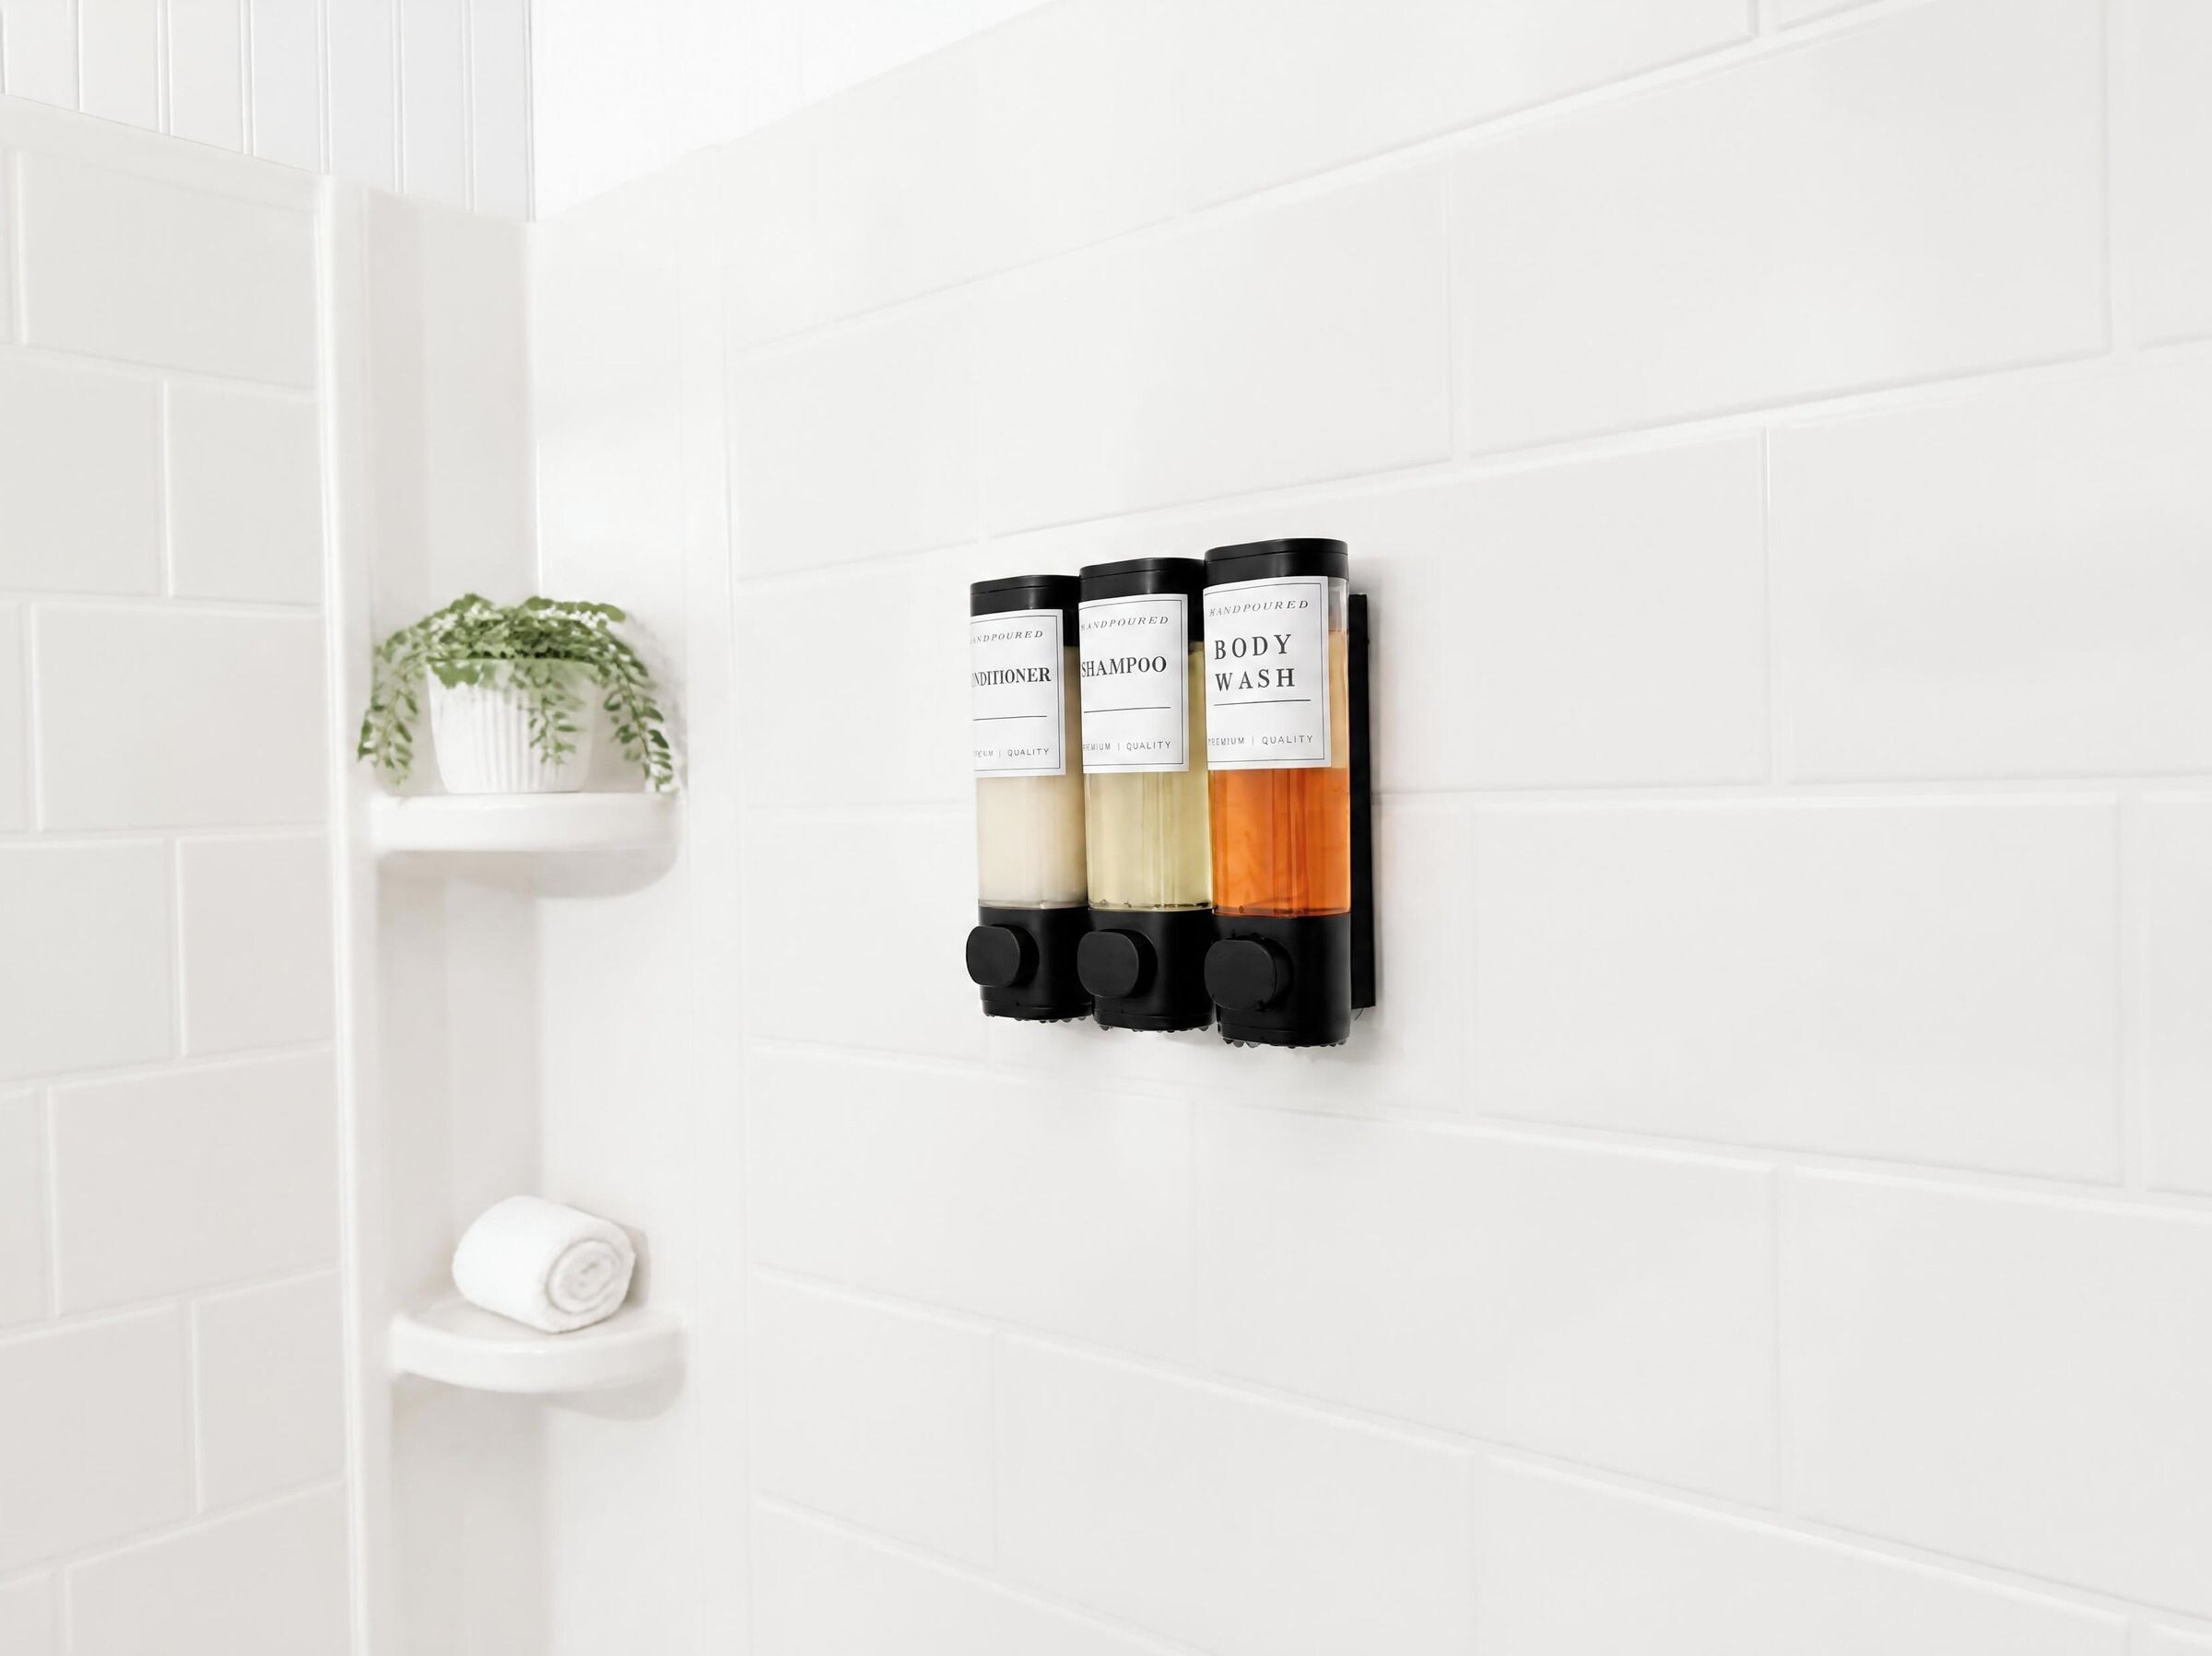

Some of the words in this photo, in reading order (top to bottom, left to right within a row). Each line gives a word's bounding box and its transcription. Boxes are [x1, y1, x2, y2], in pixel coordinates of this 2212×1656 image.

[1209, 600, 1309, 617] HANDPOURED
[972, 630, 1043, 643] ANDPOURED
[1214, 634, 1291, 660] BODY
[1081, 656, 1167, 677] SHAMPOO
[972, 667, 1052, 687] NDITIONER
[1215, 668, 1295, 692] WASH
[1126, 741, 1171, 751] QUALITY
[1262, 735, 1313, 746] QUALITY
[1007, 748, 1049, 758] QUALITY
